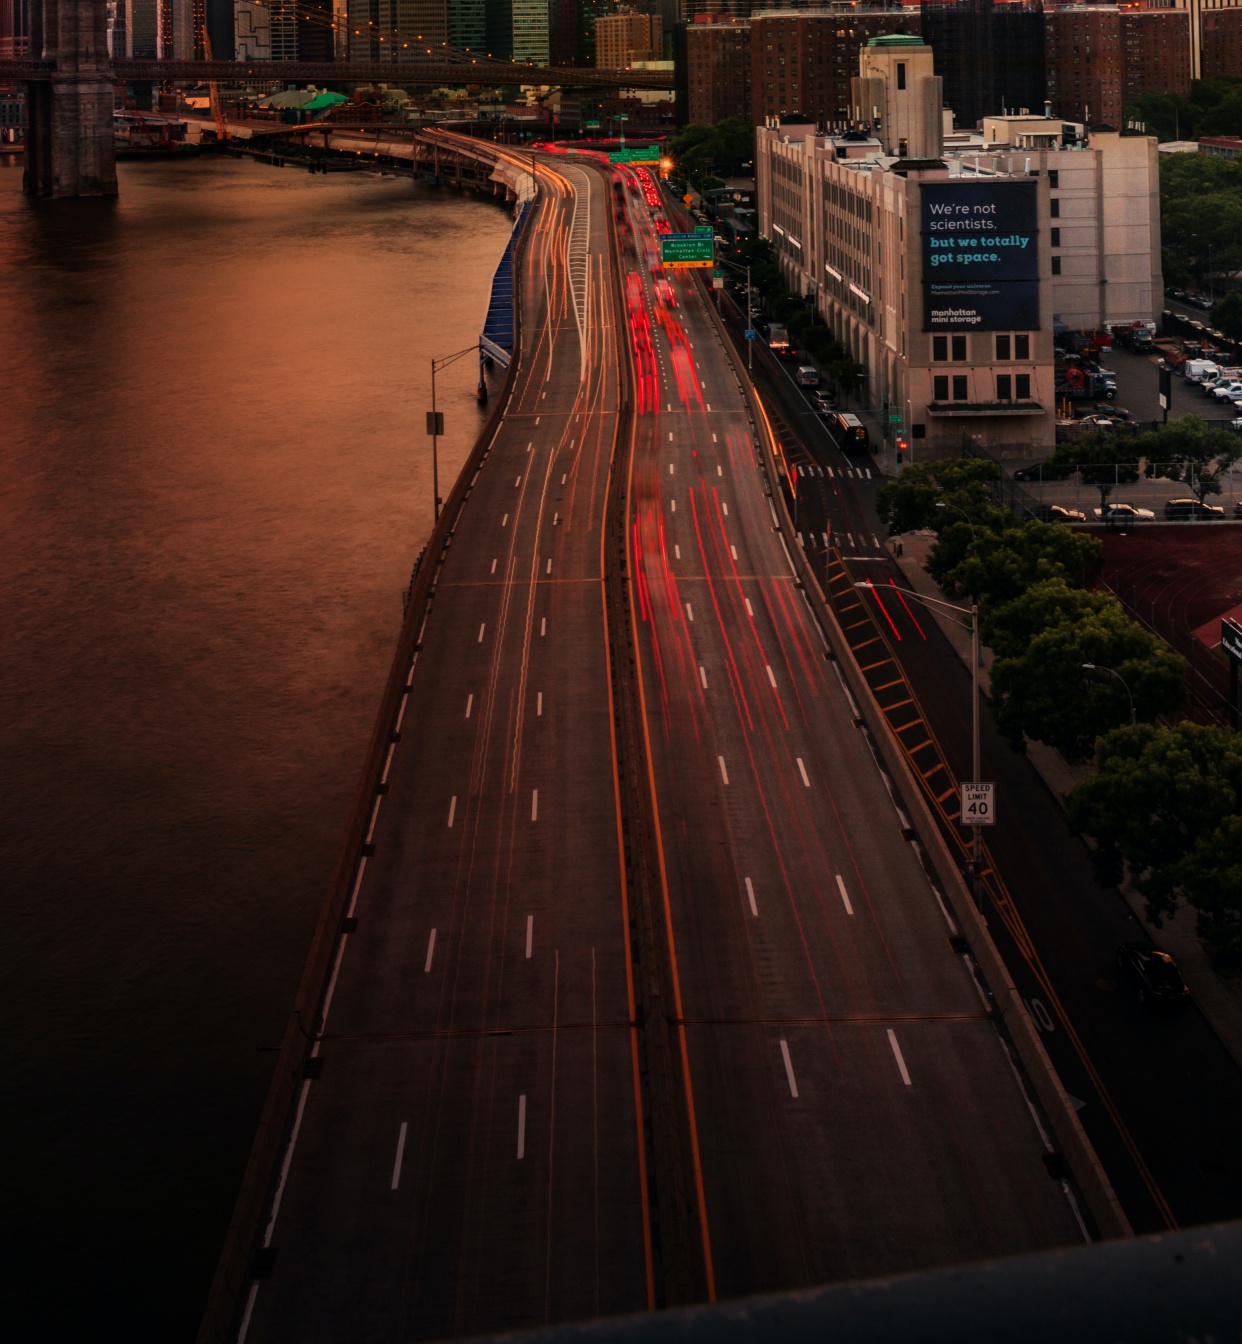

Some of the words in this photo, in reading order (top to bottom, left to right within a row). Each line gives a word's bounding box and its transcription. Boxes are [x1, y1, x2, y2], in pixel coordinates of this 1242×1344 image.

[929, 203, 970, 215] We're
[973, 203, 997, 214] not
[930, 218, 997, 230] scientists,
[930, 236, 955, 248] but
[957, 238, 978, 246] we
[980, 234, 1030, 249] totally
[930, 252, 954, 267] got
[956, 253, 1001, 265] space.
[931, 307, 976, 316] manhattan
[931, 315, 949, 323] mini
[950, 316, 982, 325] storage
[968, 803, 988, 814] 40
